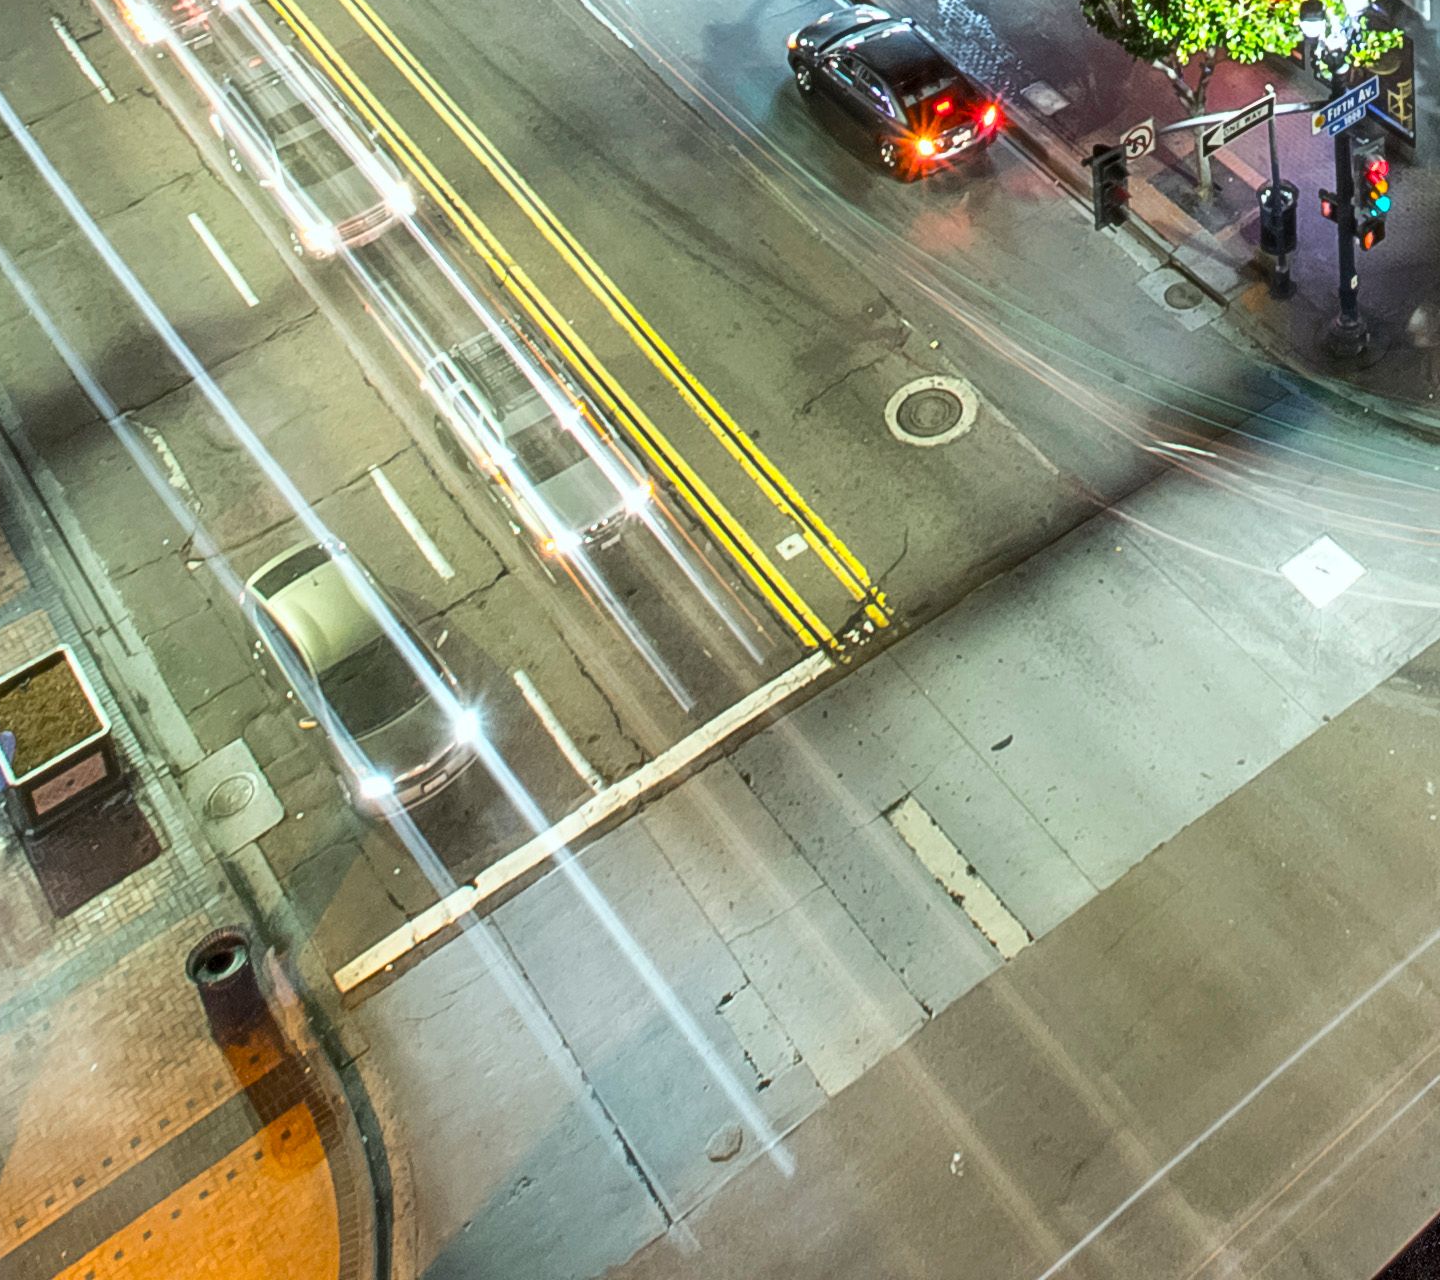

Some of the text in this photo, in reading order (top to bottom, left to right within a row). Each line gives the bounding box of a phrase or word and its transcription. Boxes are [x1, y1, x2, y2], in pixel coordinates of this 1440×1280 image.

[1223, 104, 1269, 138] ONE WAY
[1327, 96, 1355, 122] FIFTH
